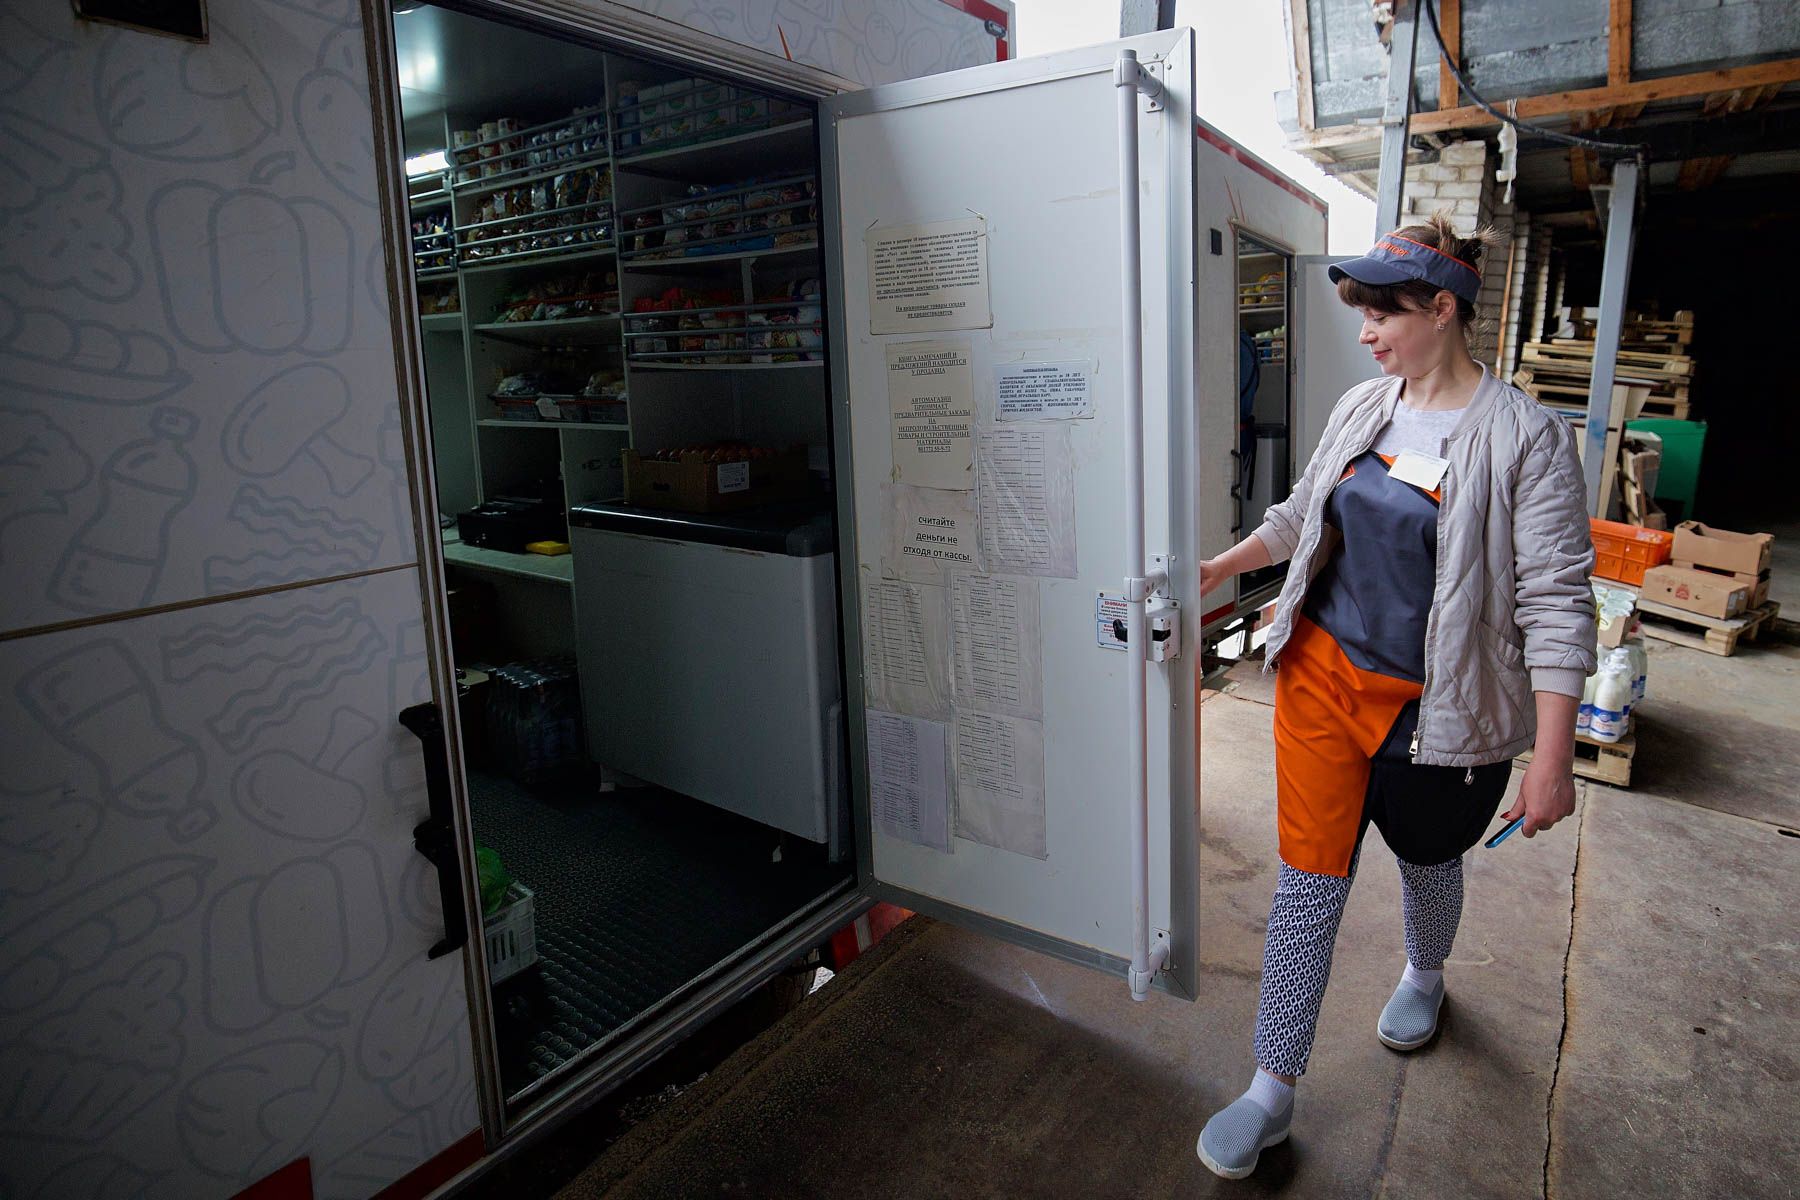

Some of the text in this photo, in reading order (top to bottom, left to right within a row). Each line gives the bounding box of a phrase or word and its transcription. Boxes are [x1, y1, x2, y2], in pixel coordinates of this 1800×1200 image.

[899, 354, 916, 362] КНИГА
[918, 352, 952, 361] ЗАМЕЧАНИЙ
[890, 358, 966, 370] ПРЕДЛОЖЕНИЙ НАХОДИТСЯ
[916, 368, 946, 376] ПРОДАВЦА
[912, 396, 952, 404] АВТОМАГАЗИН
[918, 516, 956, 527] считайте
[916, 533, 958, 544] деньги не
[903, 546, 972, 562] отходя от кассы.
